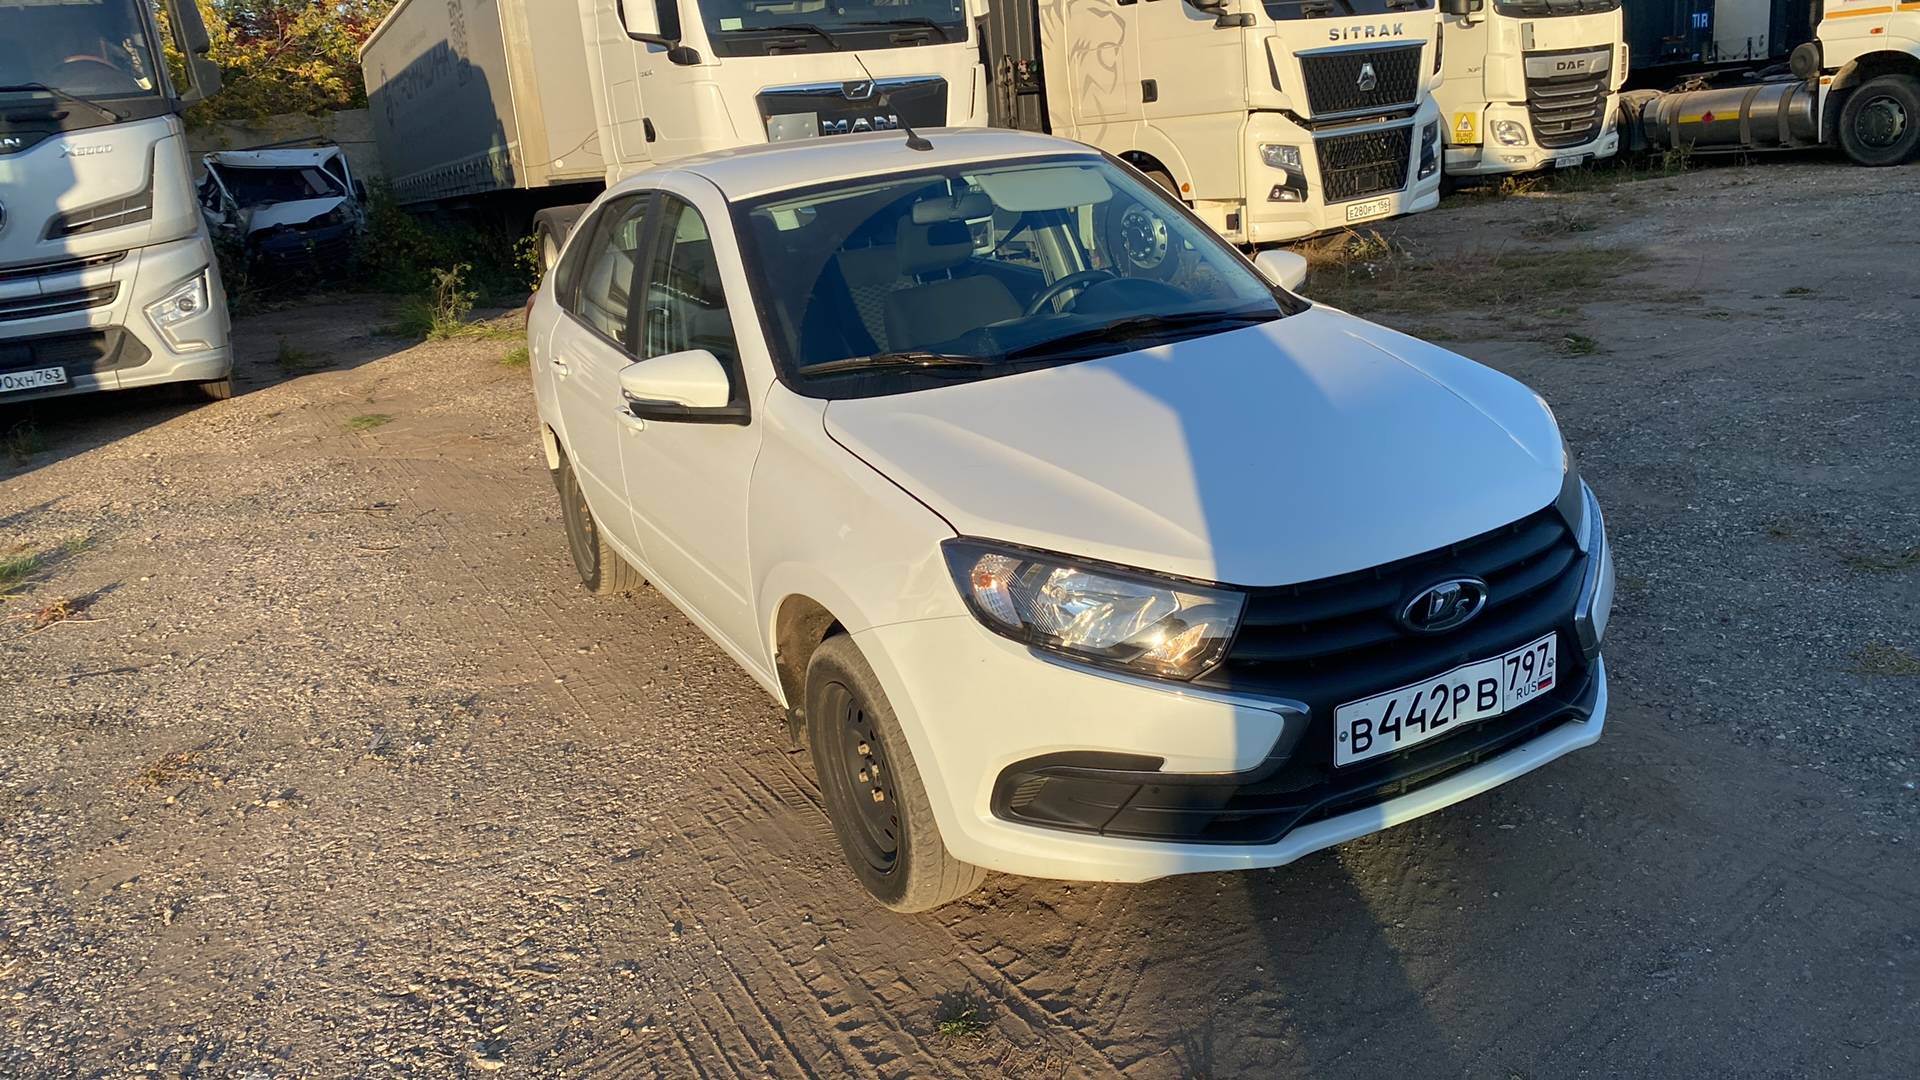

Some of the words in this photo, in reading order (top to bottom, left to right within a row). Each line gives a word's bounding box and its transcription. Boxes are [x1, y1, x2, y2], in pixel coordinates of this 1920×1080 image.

[1692, 13, 1709, 29] TIR
[1328, 22, 1403, 41] SITRAK
[1556, 60, 1585, 70] DAF
[822, 115, 899, 135] MAN
[0, 375, 35, 389] 0ХН
[36, 369, 60, 381] 763
[1507, 642, 1549, 691] 797
[1516, 681, 1537, 700] RUS
